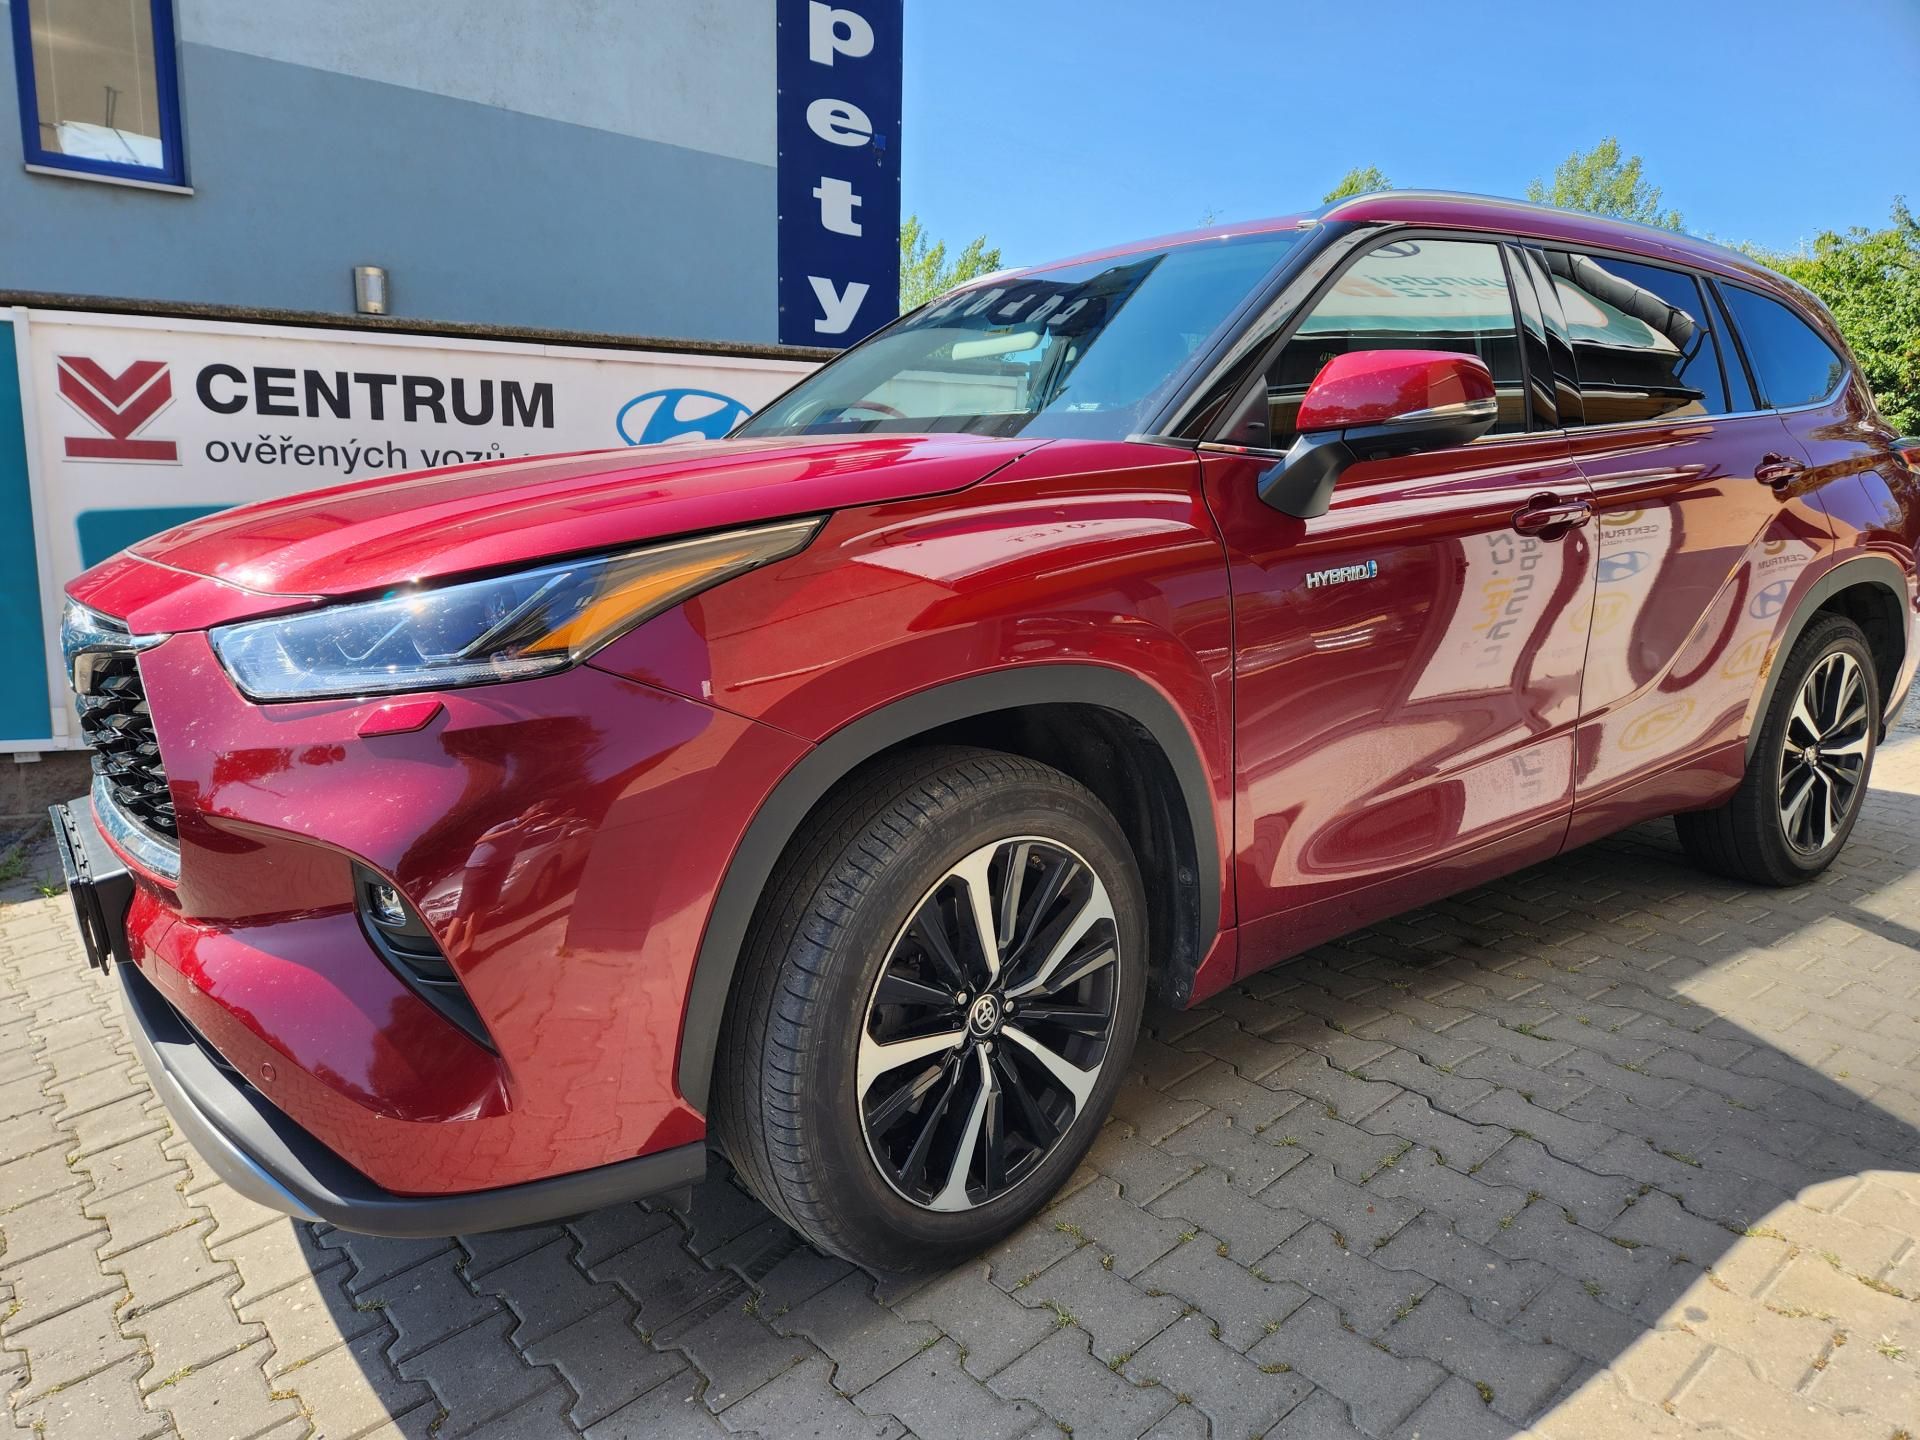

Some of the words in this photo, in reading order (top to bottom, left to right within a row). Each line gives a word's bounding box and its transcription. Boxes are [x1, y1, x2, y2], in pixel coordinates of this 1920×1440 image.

[806, 0, 875, 334] pety
[195, 363, 555, 429] CENTRUM
[205, 433, 408, 475] ověřených
[1306, 565, 1369, 589] HYBRID
